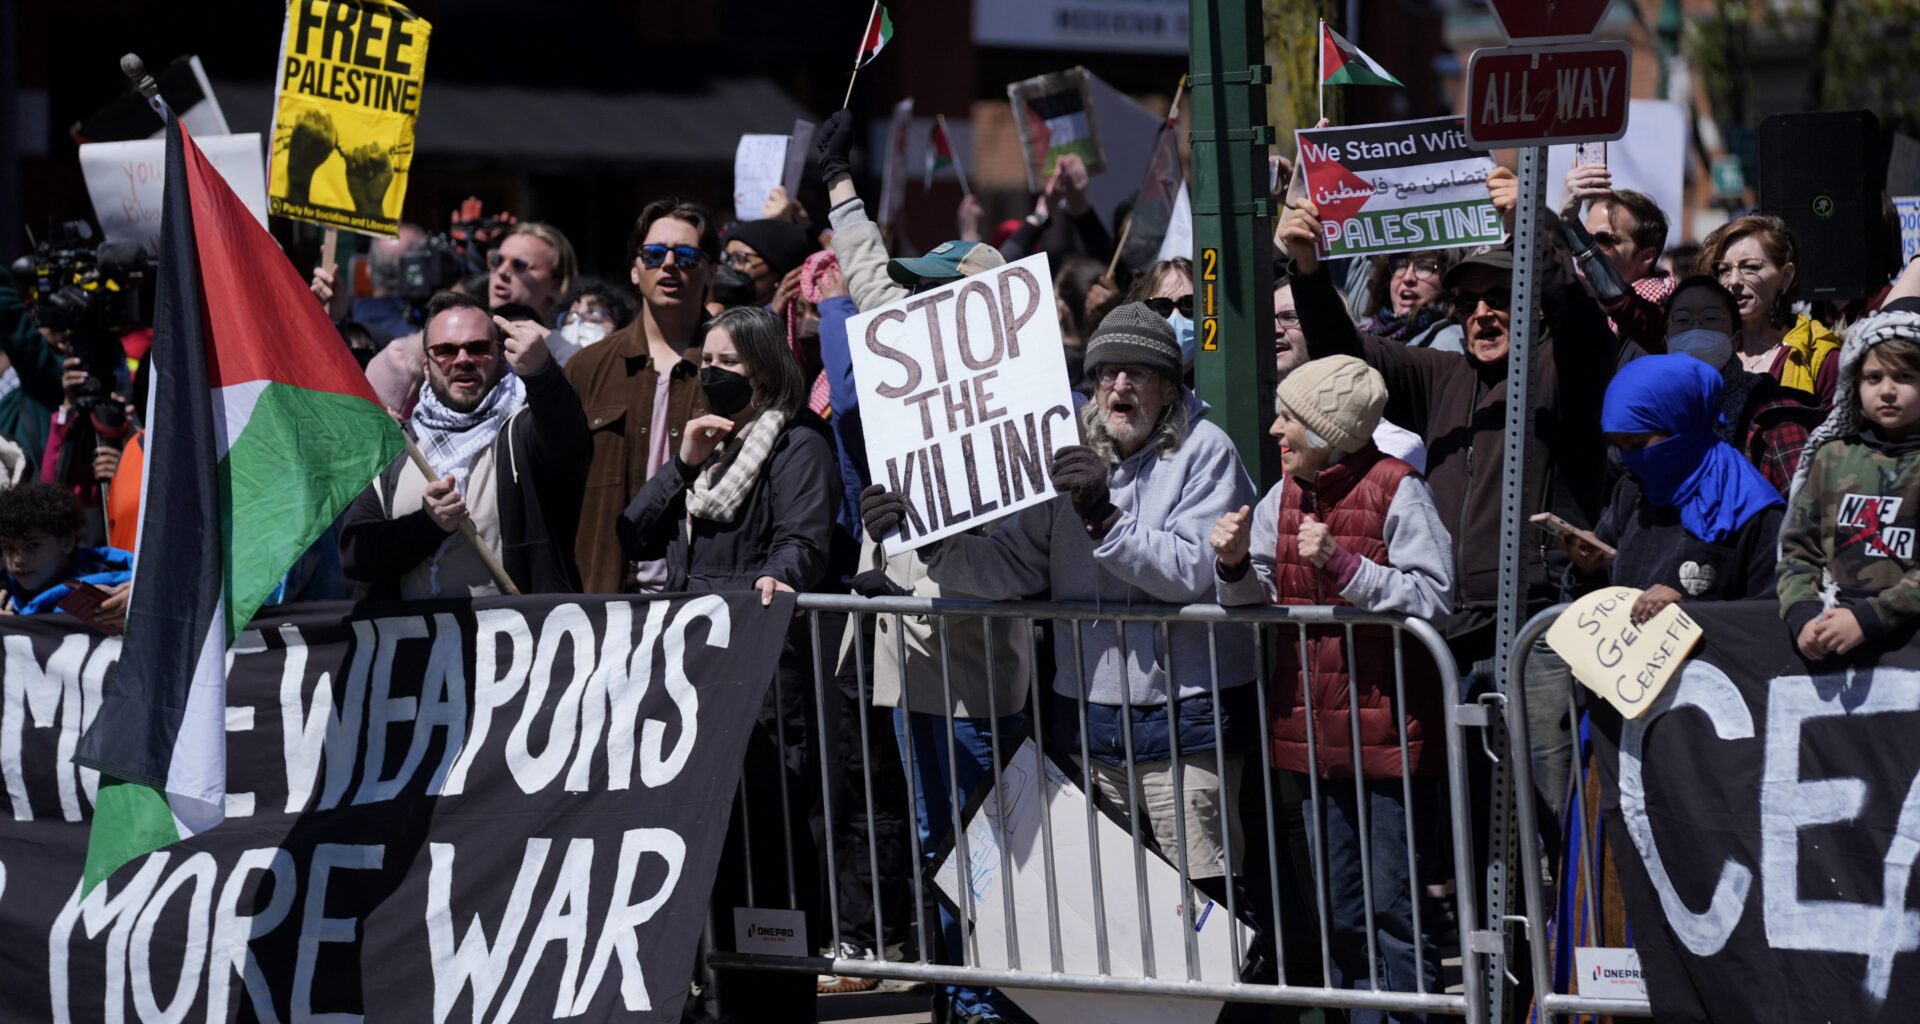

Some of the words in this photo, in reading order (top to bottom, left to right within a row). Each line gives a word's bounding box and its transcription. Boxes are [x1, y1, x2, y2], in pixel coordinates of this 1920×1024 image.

[295, 0, 414, 75] FREE
[283, 57, 419, 115] PALESTINE
[1481, 71, 1536, 124] ALL
[1556, 66, 1616, 121] WAY
[1304, 143, 1341, 163] We
[1346, 134, 1417, 161] Stand
[1421, 129, 1468, 152] Wit
[1316, 176, 1389, 205] فلسطين
[1394, 183, 1418, 200] مع
[283, 202, 303, 215] Party
[304, 206, 315, 217] for
[316, 208, 350, 224] Socialism
[351, 217, 366, 227] and
[1322, 204, 1500, 251] PALESTINE
[865, 266, 1041, 398] STOP
[904, 370, 1008, 440] THE
[1840, 496, 1895, 523] NE
[1578, 591, 1631, 636] STOP
[280, 594, 730, 813] WEAPONS
[49, 844, 386, 1024] MORE
[426, 828, 686, 1024] WAR
[757, 927, 794, 937] ONEPRO
[1604, 969, 1644, 979] ONEPR
